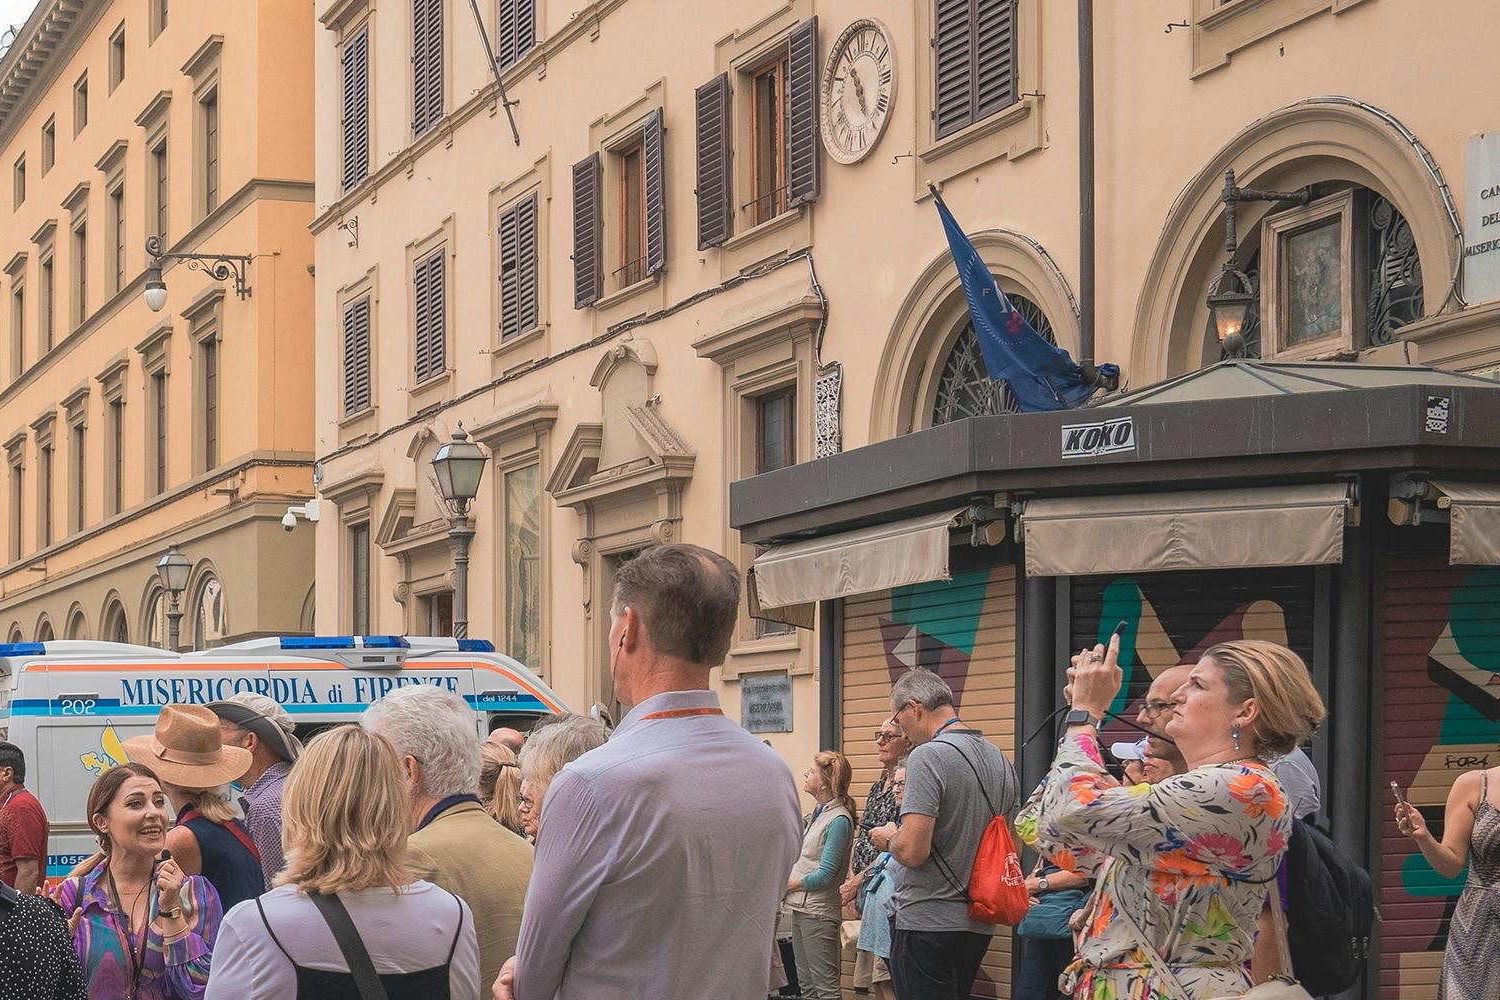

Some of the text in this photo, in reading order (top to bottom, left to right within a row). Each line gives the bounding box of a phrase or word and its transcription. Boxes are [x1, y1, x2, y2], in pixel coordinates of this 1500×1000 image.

[1064, 422, 1132, 451] KOKO
[327, 684, 342, 703] di
[61, 699, 96, 715] 202
